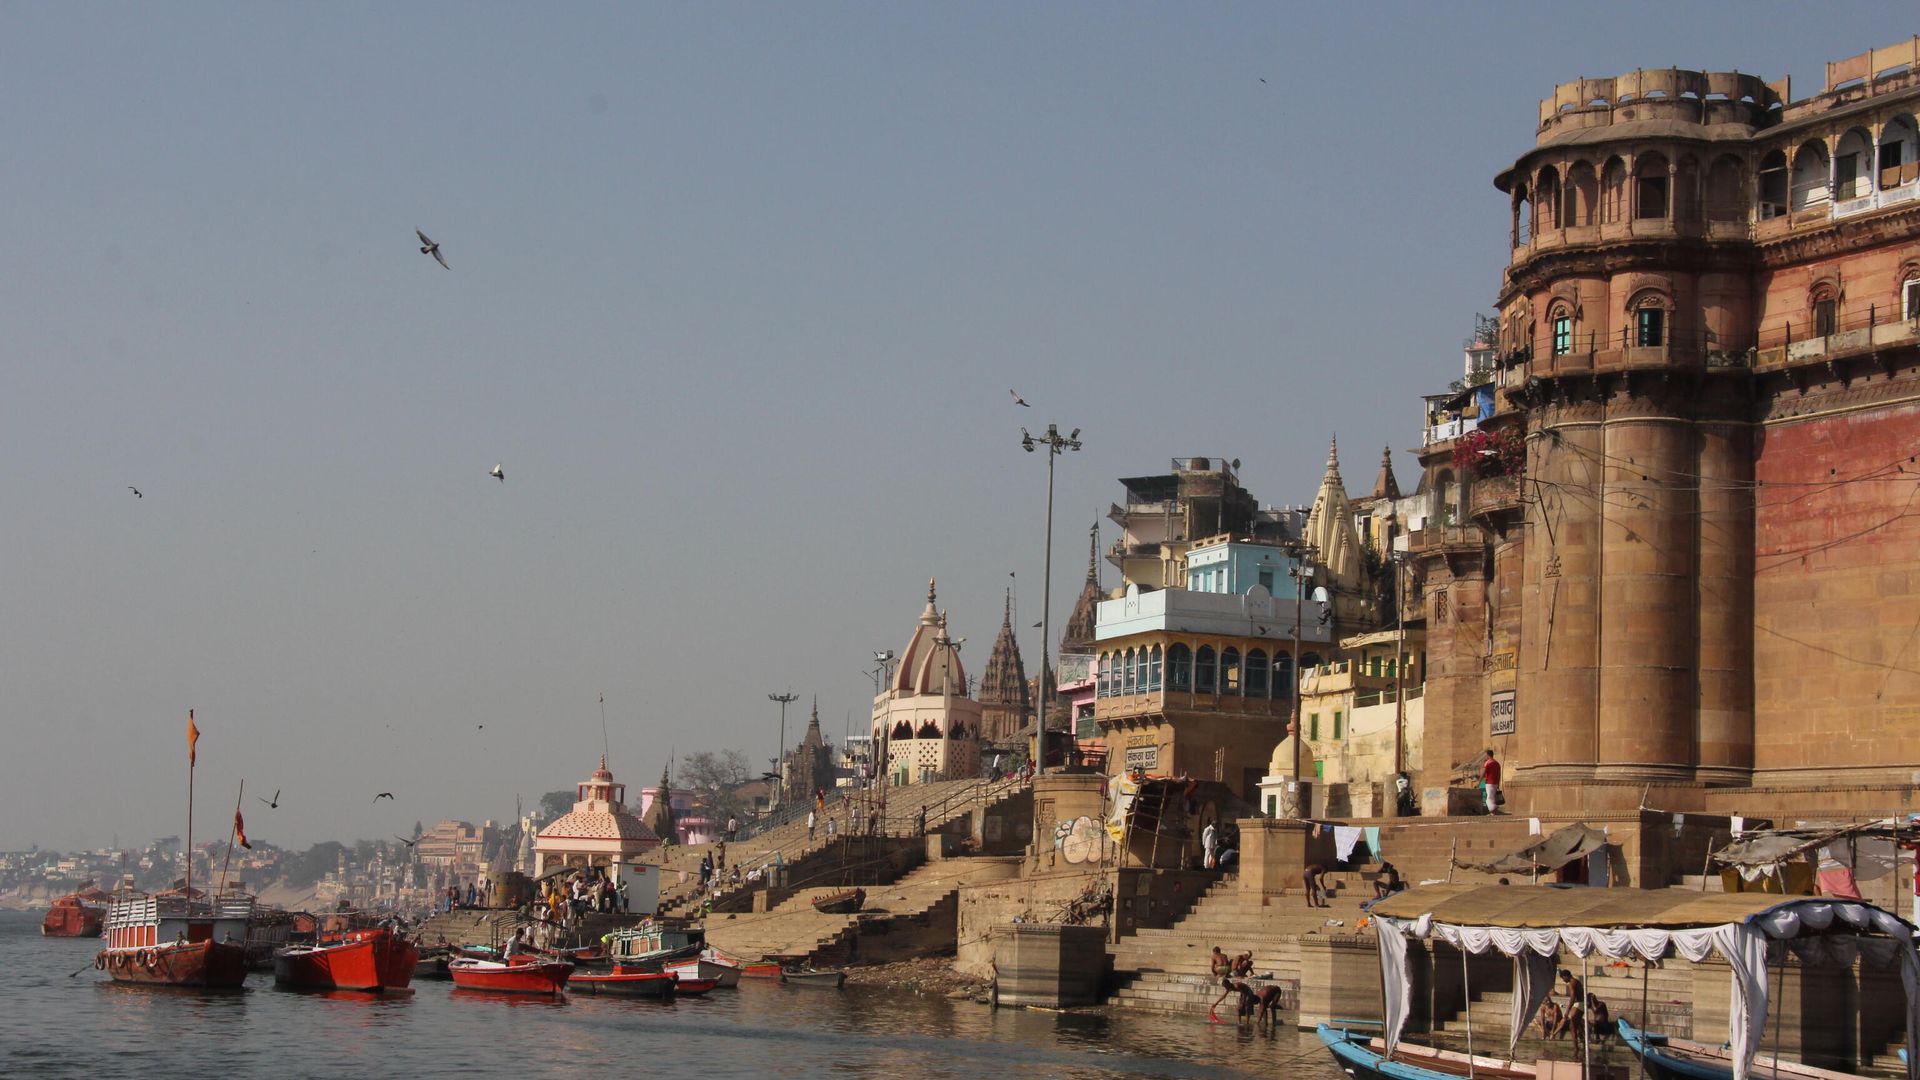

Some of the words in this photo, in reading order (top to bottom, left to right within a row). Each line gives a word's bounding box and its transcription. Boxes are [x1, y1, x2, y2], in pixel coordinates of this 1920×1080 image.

[1500, 699, 1514, 716] घाट
[1500, 720, 1514, 731] GHAT
[1145, 750, 1156, 760] घाट
